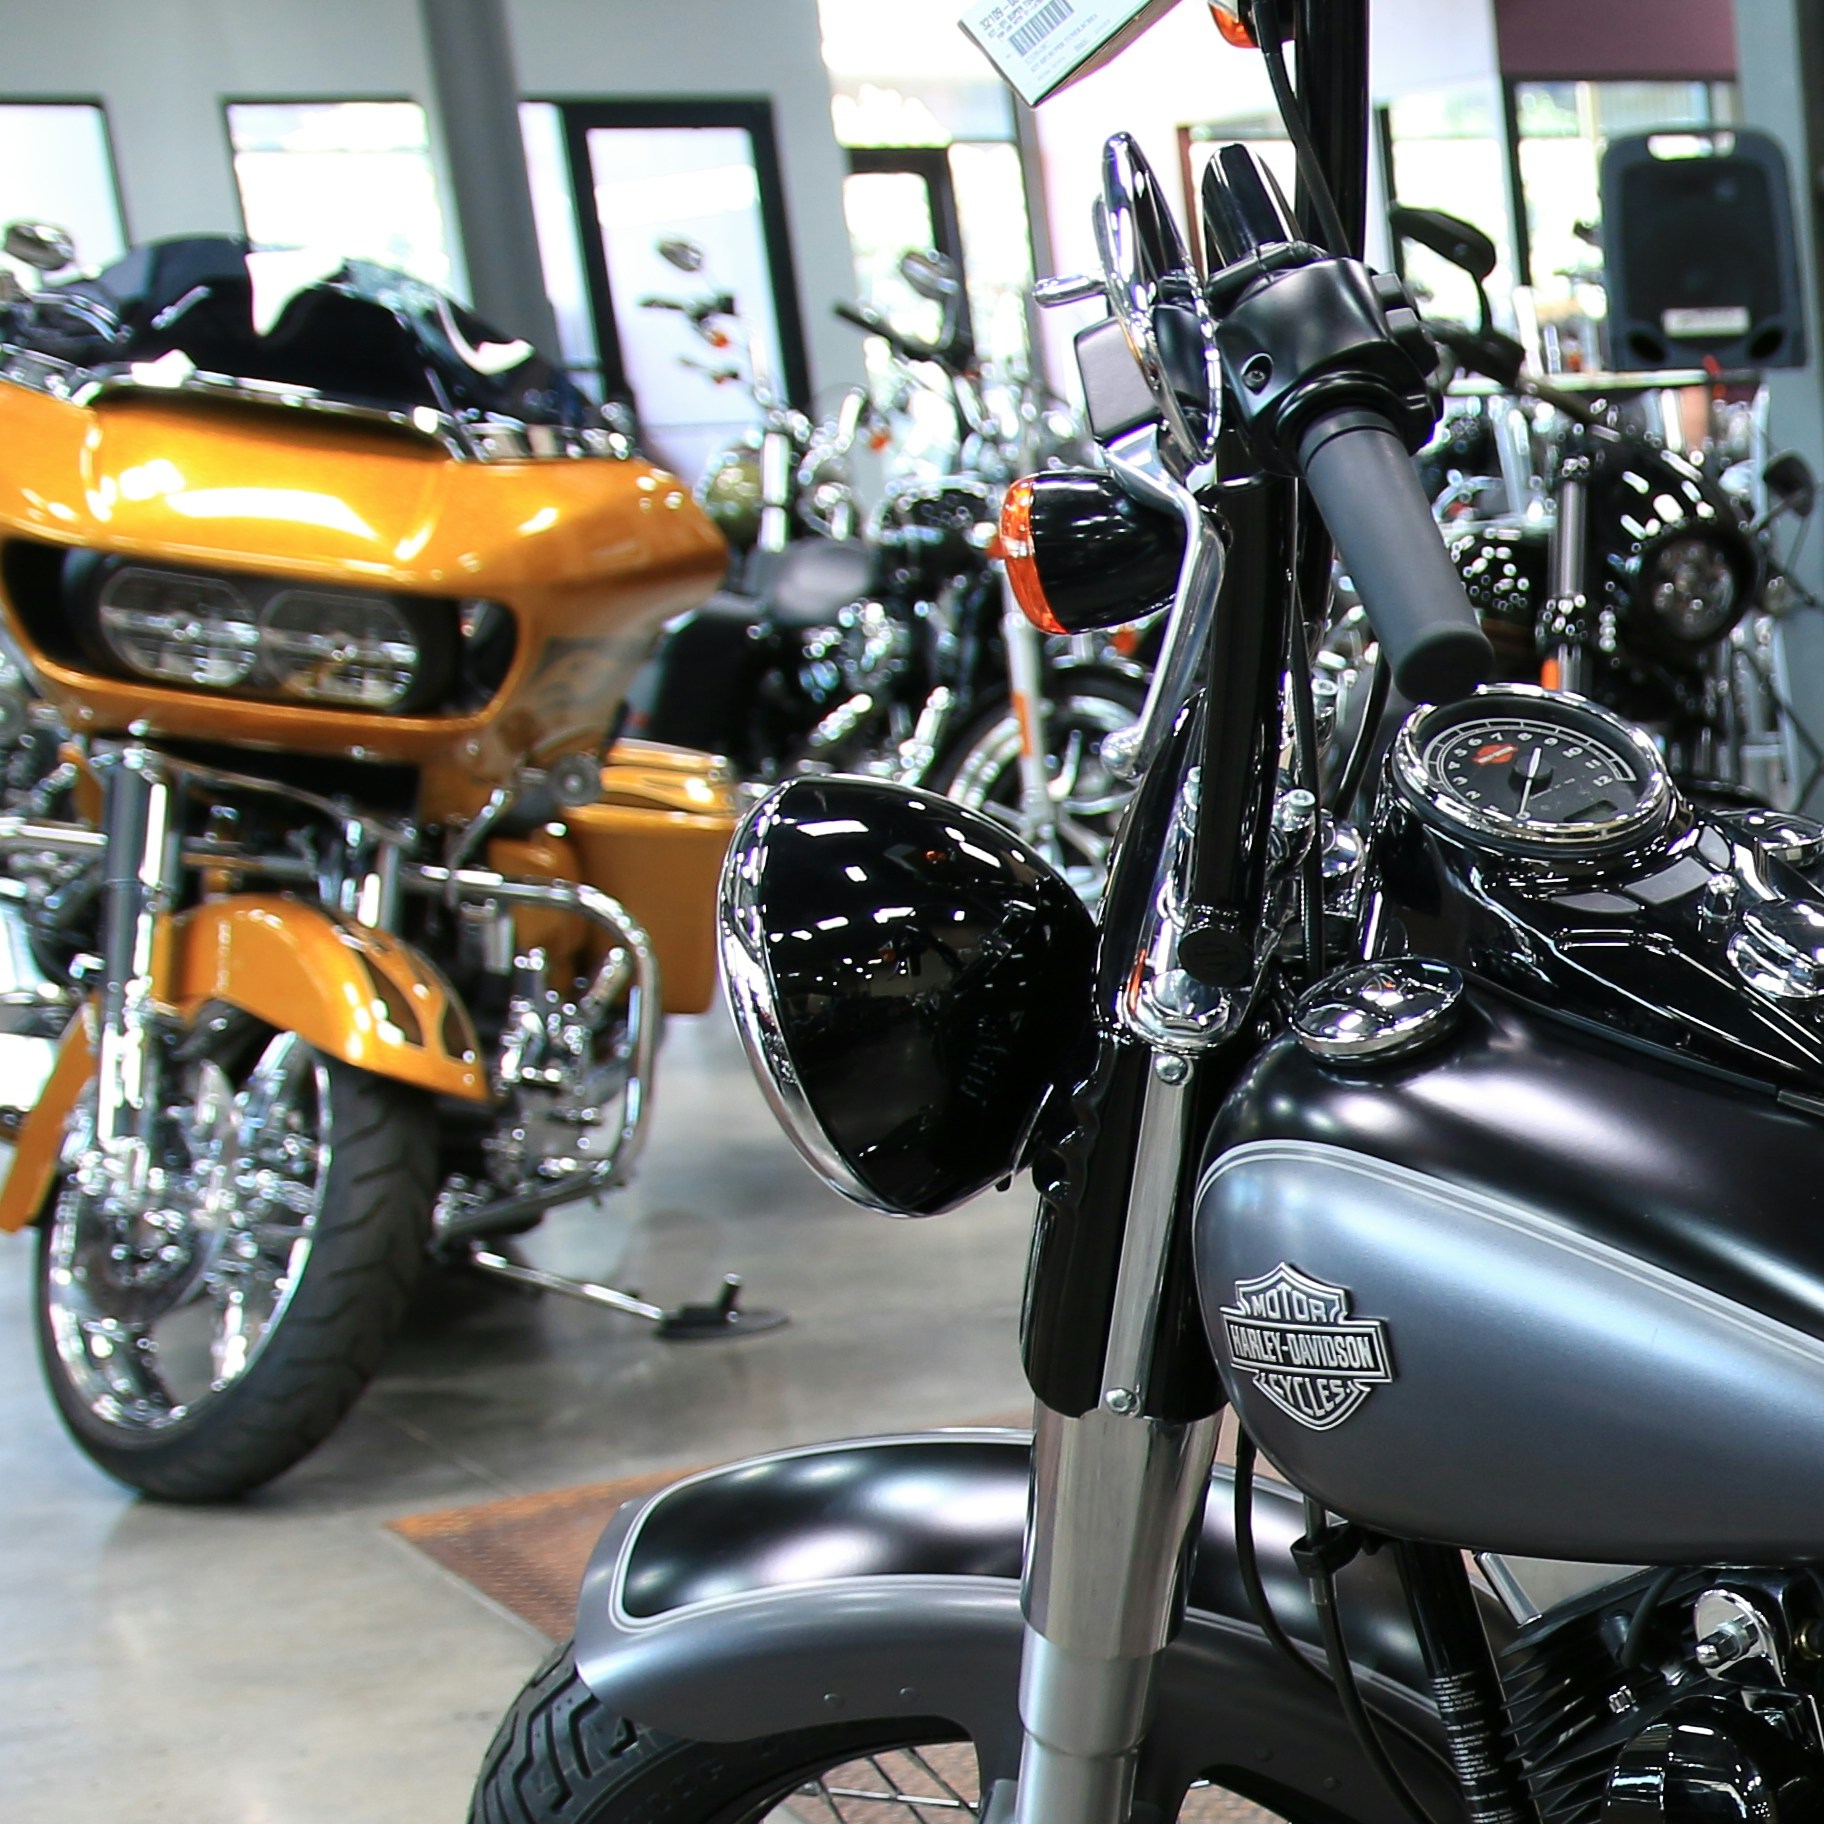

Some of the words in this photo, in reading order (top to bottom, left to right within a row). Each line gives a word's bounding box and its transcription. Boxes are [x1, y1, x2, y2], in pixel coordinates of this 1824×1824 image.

[1490, 732, 1504, 742] 7
[1517, 732, 1533, 741] 8
[1544, 737, 1558, 746] 9
[1468, 737, 1483, 747] 6
[1454, 748, 1468, 758] 5
[1562, 746, 1583, 758] 10
[1448, 761, 1461, 770] 4
[1585, 759, 1602, 769] 11
[1453, 776, 1468, 785] 3
[1593, 775, 1613, 787] 12
[1466, 790, 1481, 800] 2
[1251, 1281, 1328, 1323] MOTOR
[1229, 1324, 1376, 1369] HARLEY-DAVIDSON
[1267, 1373, 1346, 1417] CYCLES
